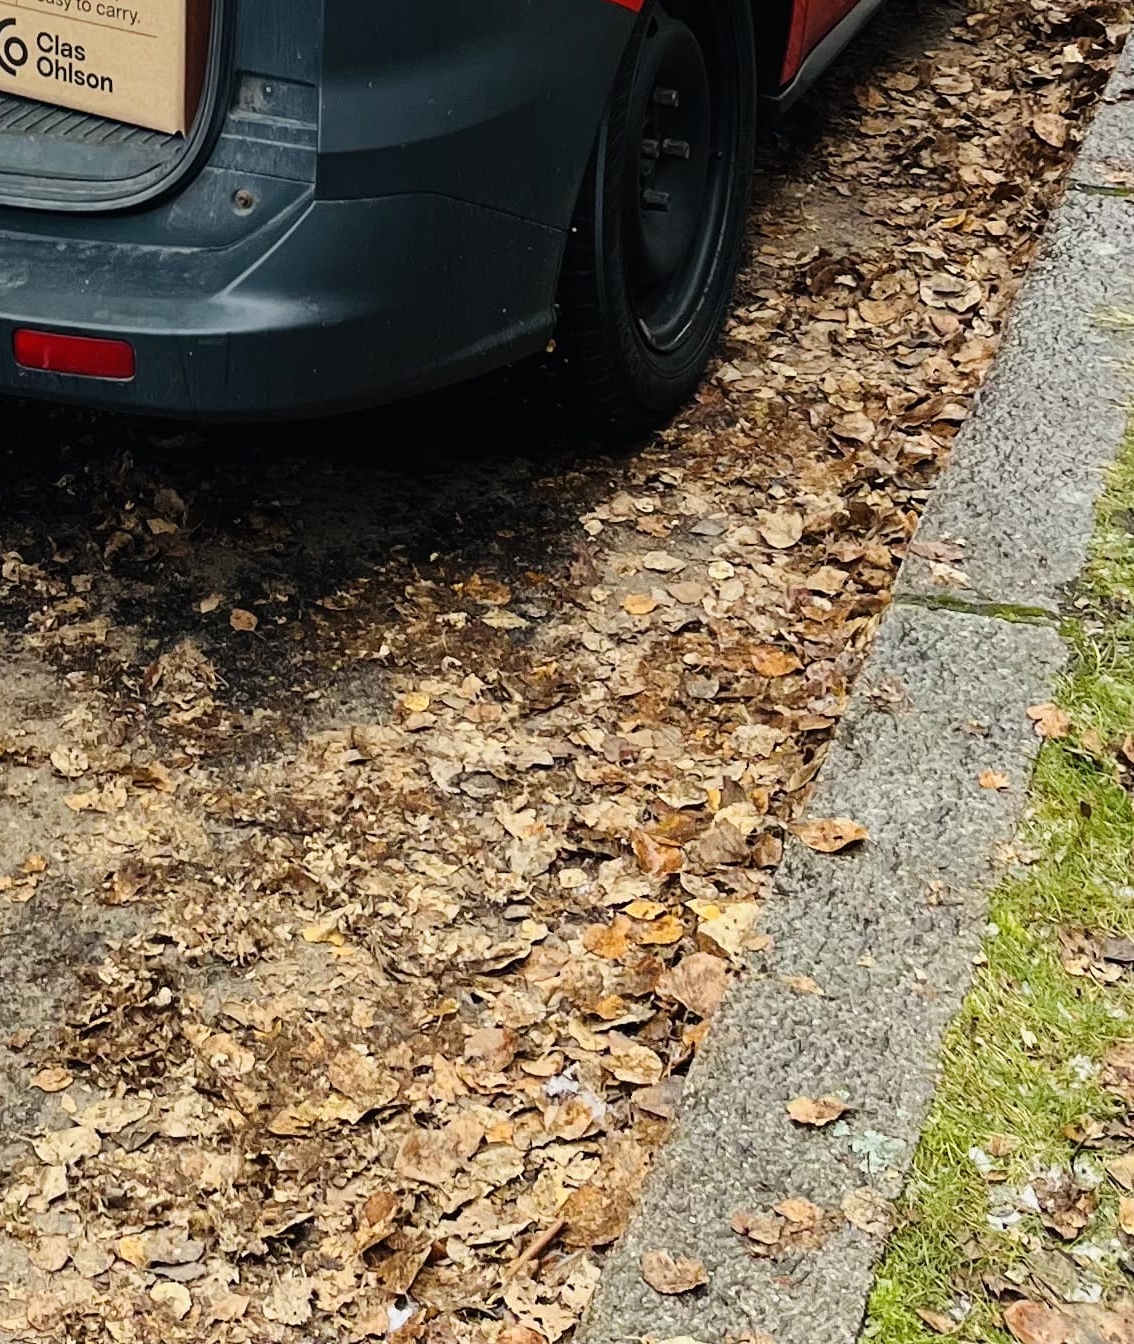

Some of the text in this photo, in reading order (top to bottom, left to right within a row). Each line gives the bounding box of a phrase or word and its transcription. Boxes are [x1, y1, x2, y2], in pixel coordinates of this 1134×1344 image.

[96, 3, 141, 26] carry.
[36, 31, 86, 61] Clas
[36, 55, 114, 93] Ohlson
